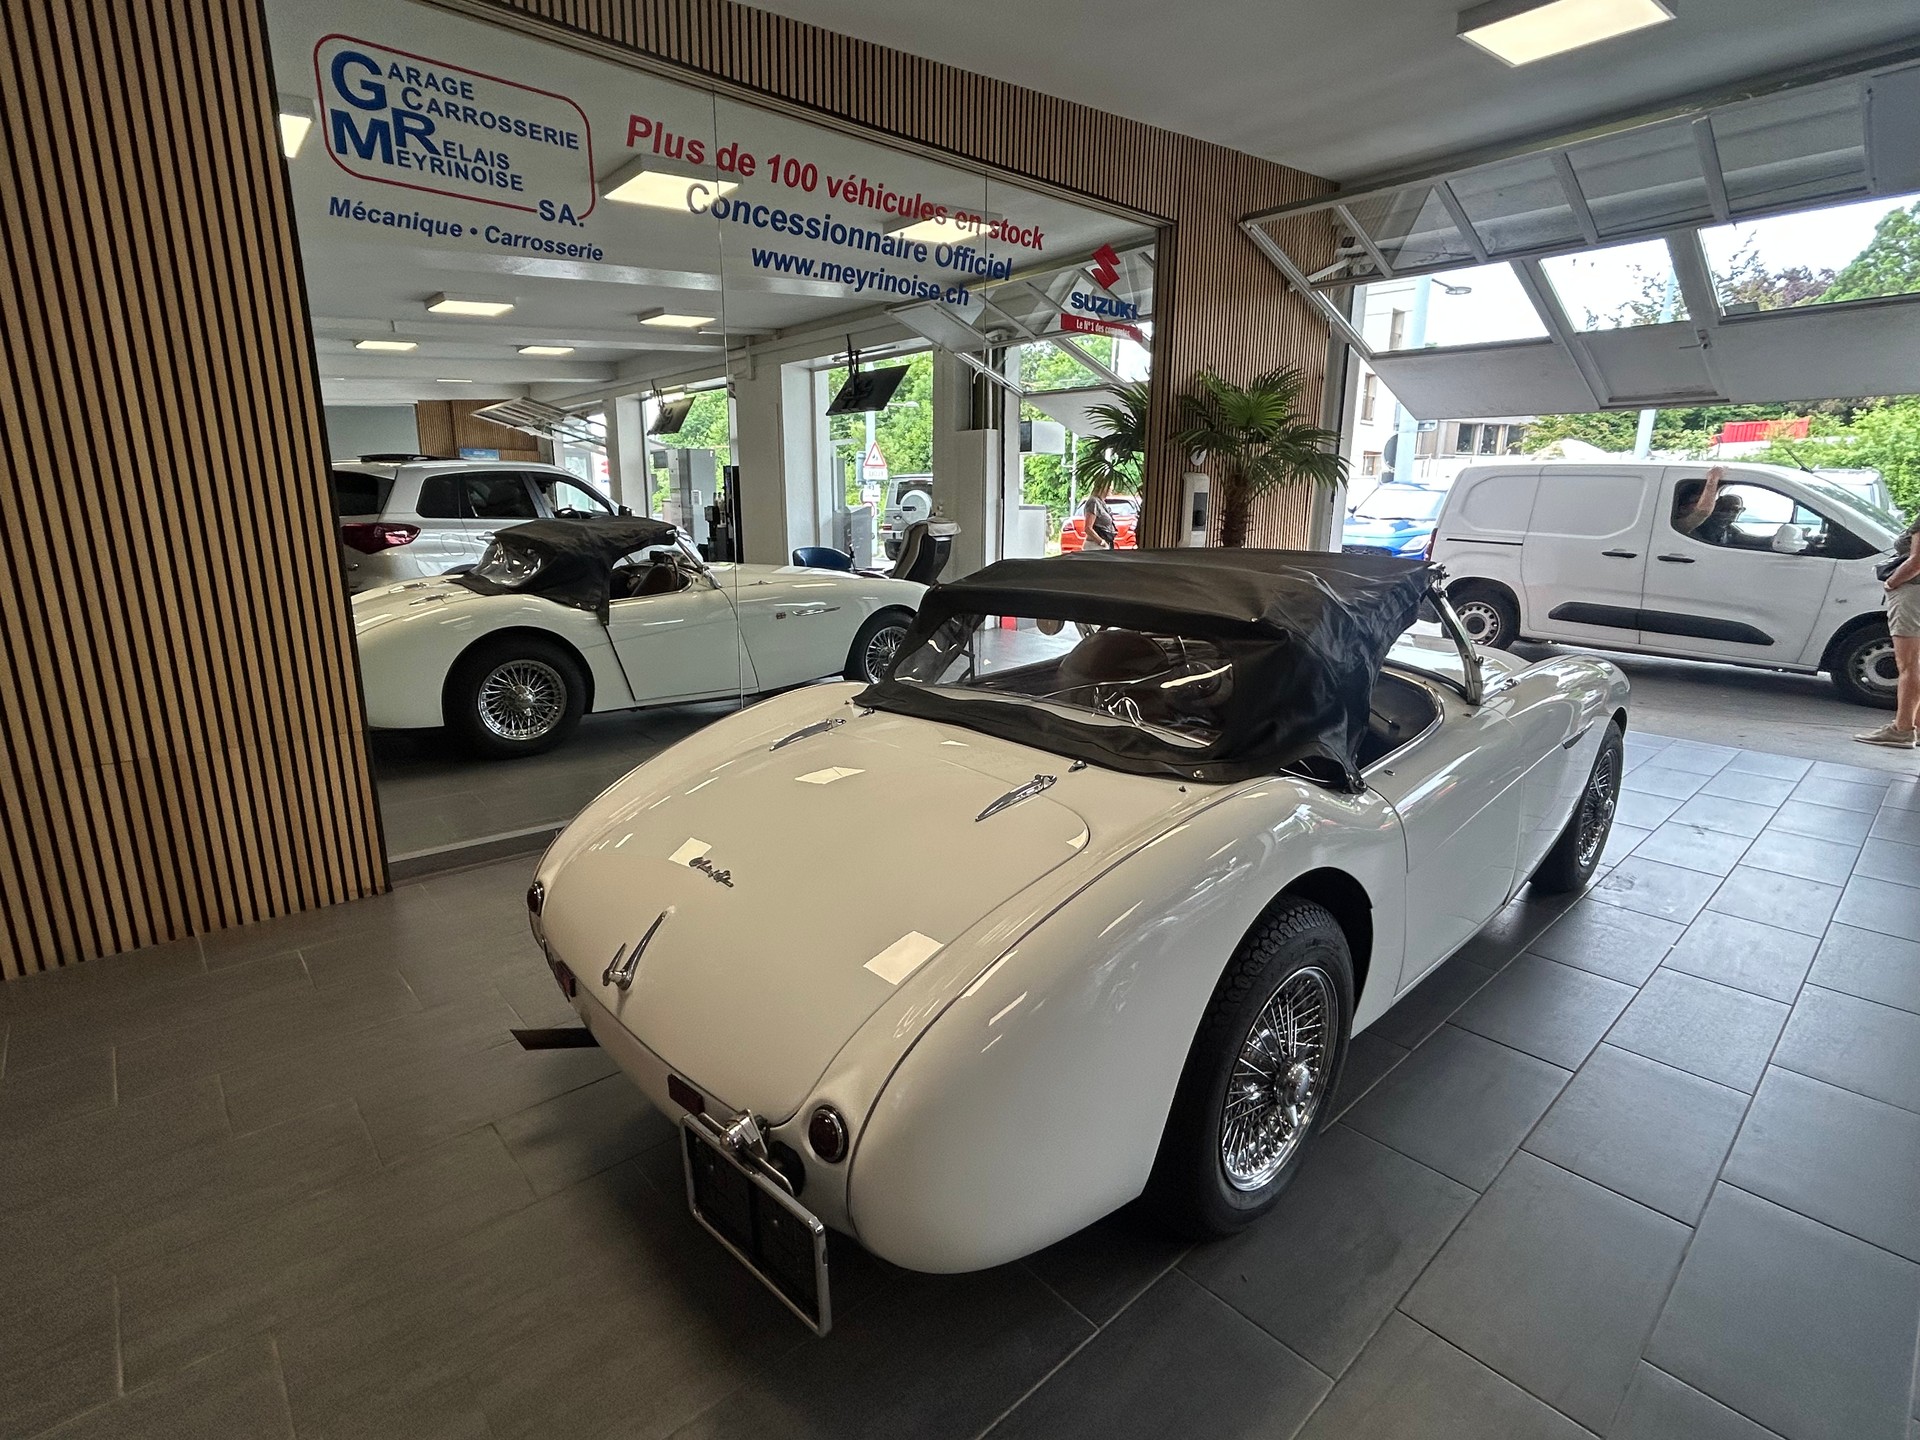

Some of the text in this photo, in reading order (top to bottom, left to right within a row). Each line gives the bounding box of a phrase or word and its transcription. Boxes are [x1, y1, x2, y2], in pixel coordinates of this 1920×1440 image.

[331, 50, 475, 111] GARAGE
[330, 108, 524, 192] MEYRINOISE
[391, 107, 511, 170] RELAIS
[401, 86, 580, 151] CARROSSERIE
[538, 199, 585, 228] SA.
[626, 114, 1045, 250] Plus de 100 véhicules en stock
[328, 196, 604, 261] Mécanique Carrosserie
[686, 183, 1013, 281] Concessionnaire Officiel
[751, 247, 969, 306] www.meyrinoise.ch
[1071, 291, 1137, 320] SUZUKI
